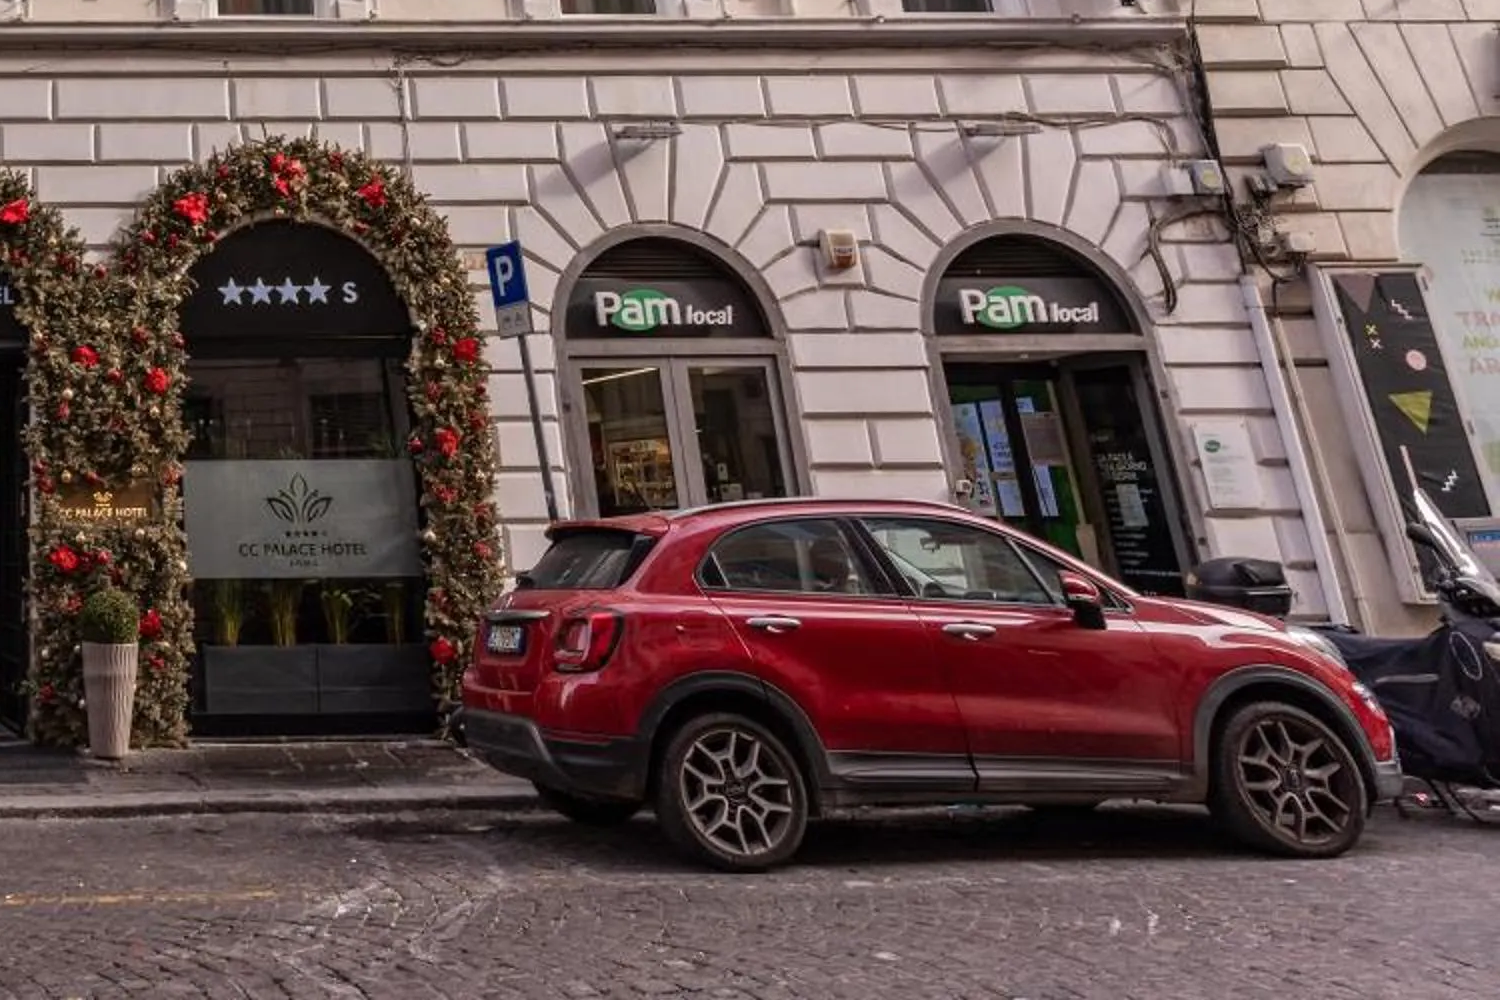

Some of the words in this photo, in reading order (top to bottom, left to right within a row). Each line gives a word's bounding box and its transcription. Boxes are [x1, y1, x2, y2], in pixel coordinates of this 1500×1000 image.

[341, 281, 358, 304] S
[494, 256, 513, 296] P
[595, 291, 682, 326] Pam
[685, 304, 733, 325] local
[958, 288, 1049, 325] Pam
[1051, 301, 1099, 323] local
[238, 543, 259, 557] CC
[263, 543, 317, 557] PALACE
[320, 543, 367, 556] HOTEL
